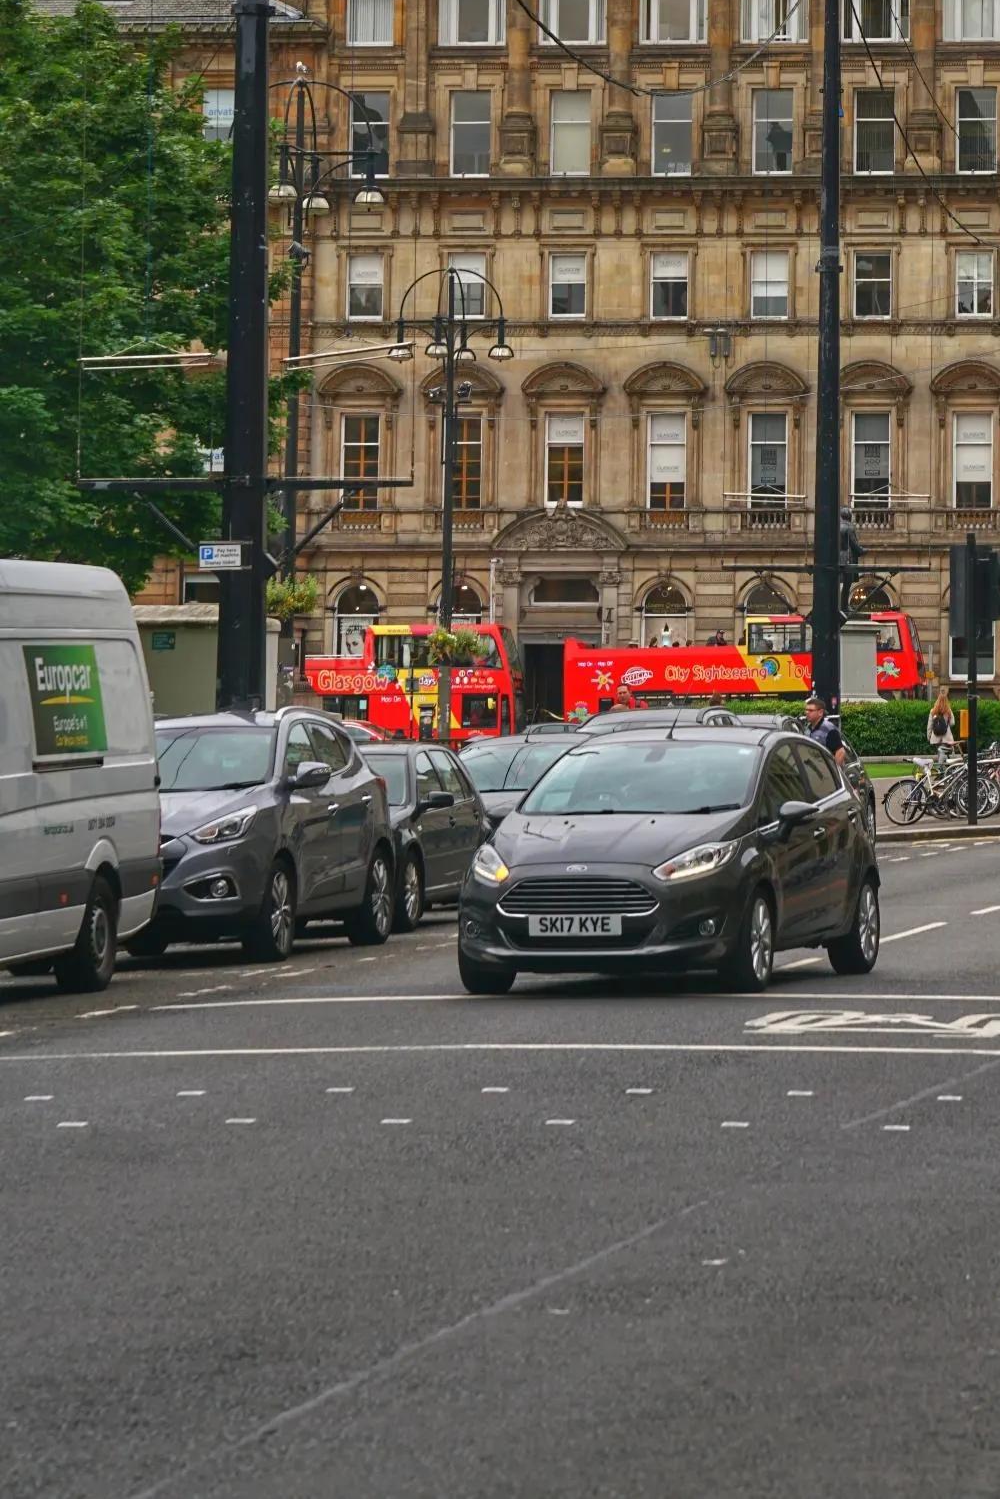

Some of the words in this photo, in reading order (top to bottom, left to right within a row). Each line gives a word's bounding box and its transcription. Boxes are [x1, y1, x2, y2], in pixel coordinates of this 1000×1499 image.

[664, 665, 690, 682] City
[692, 664, 768, 683] Sightseeing
[786, 660, 812, 679] Tou
[34, 656, 92, 703] Europcar
[318, 669, 390, 695] Glasgow
[538, 916, 575, 934] SK17
[578, 916, 612, 933] KYE
